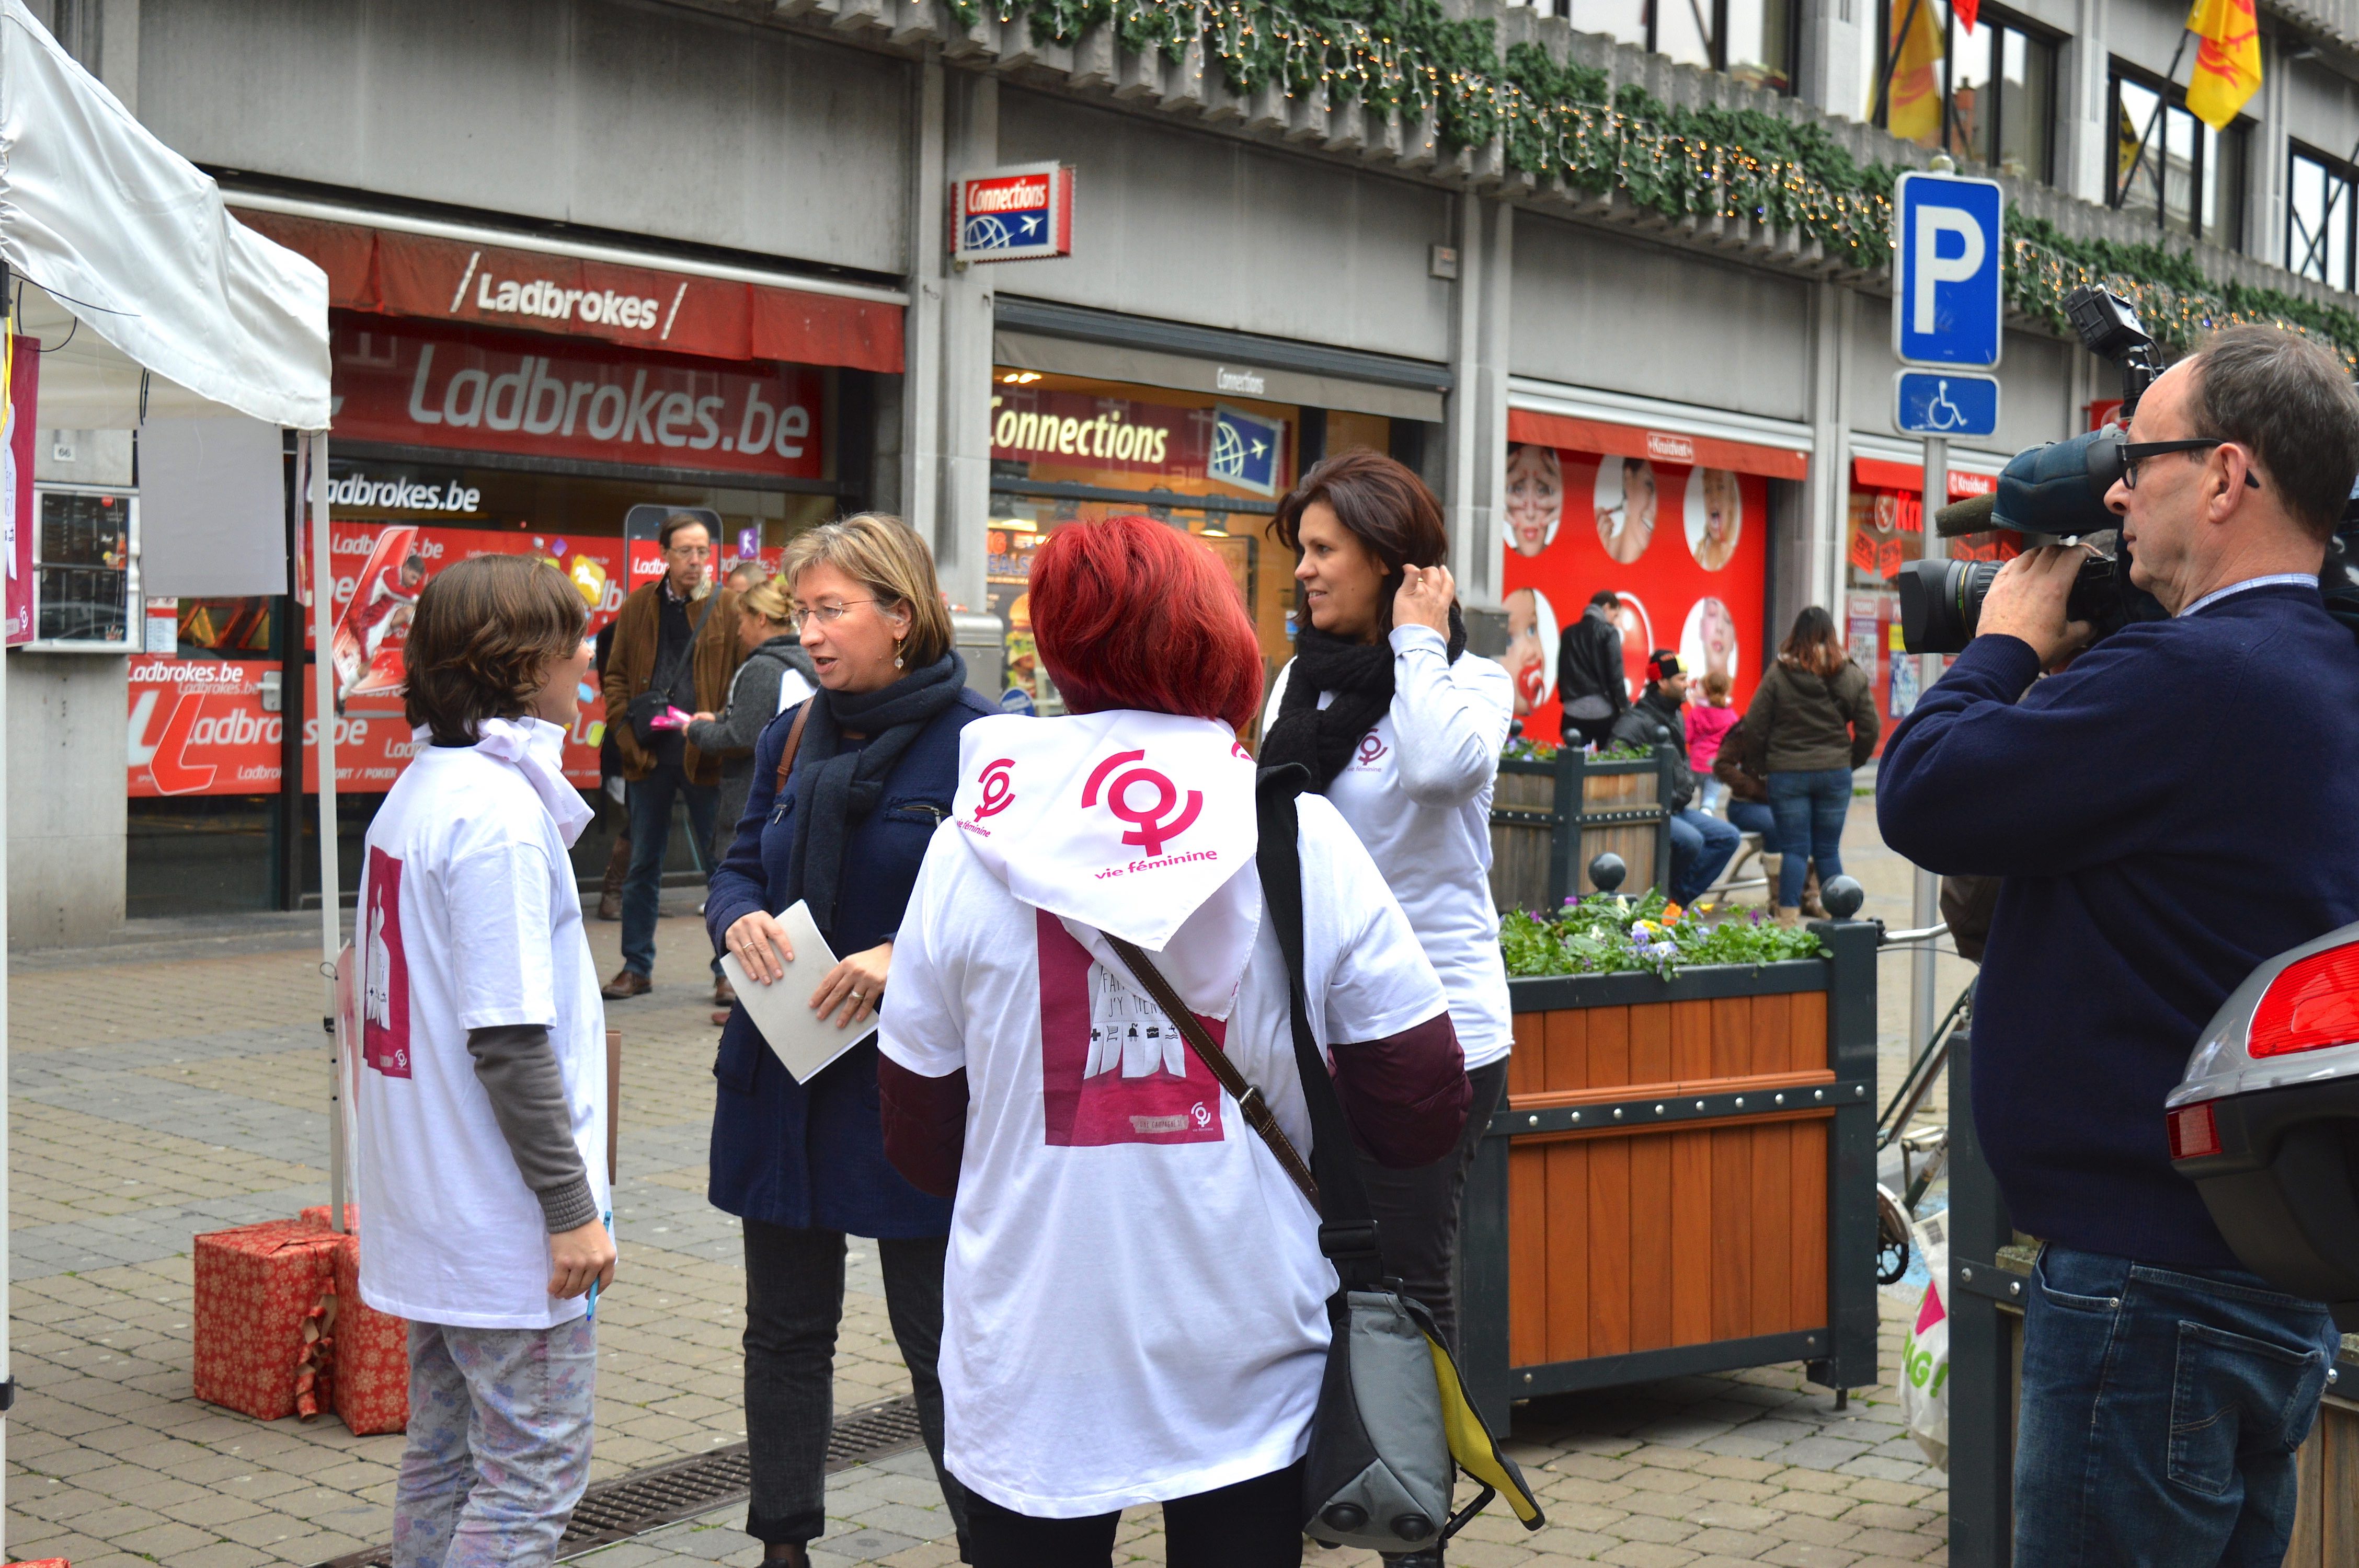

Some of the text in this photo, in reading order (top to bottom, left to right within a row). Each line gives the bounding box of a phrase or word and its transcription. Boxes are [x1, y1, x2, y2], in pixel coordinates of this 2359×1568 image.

[969, 179, 1046, 213] Connections
[1914, 204, 1985, 335] P
[408, 343, 810, 458] Ladbrokes.be
[58, 447, 72, 457] 66
[1957, 474, 1988, 494] Kruidvat
[364, 767, 398, 779] POKER
[963, 820, 991, 837] féminine
[1094, 850, 1217, 879] vie féminine
